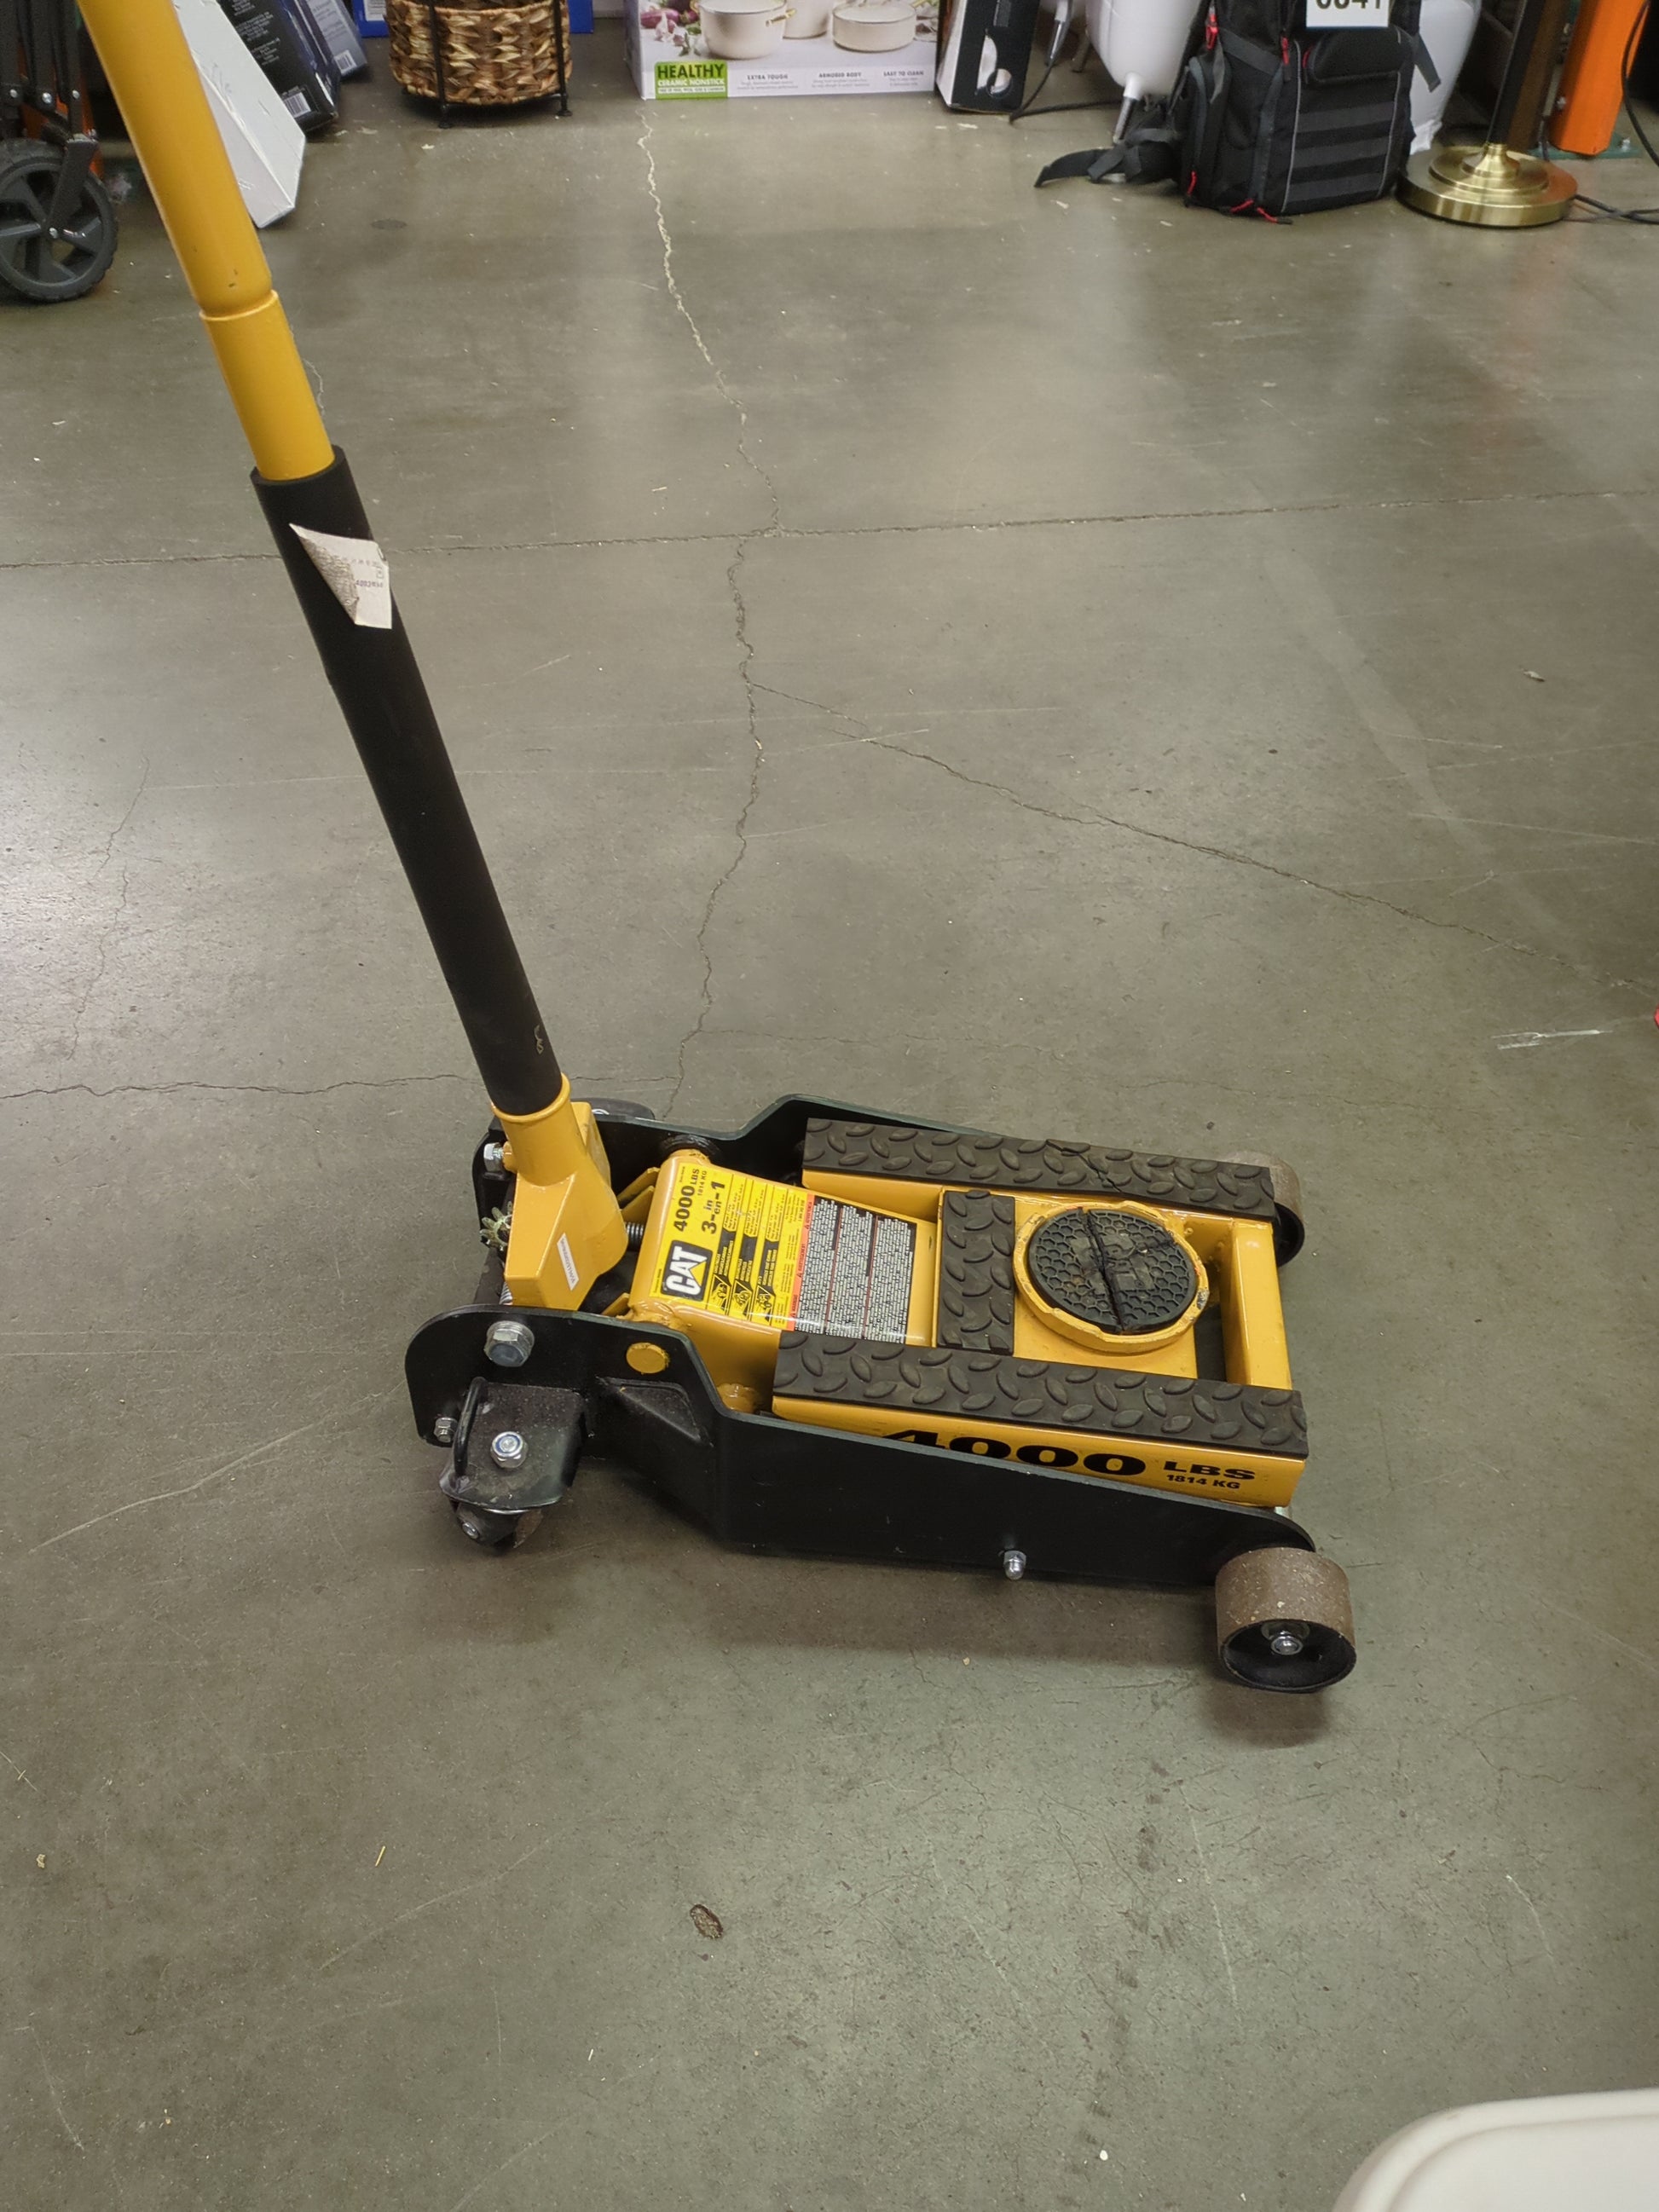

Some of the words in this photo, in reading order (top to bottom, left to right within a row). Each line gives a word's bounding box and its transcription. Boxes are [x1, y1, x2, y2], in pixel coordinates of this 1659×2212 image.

[657, 64, 725, 78] HEALTHY
[701, 1170, 708, 1181] KG
[673, 1186, 695, 1232] 4000
[690, 1169, 699, 1185] LBS
[666, 1245, 707, 1295] CAT
[882, 1429, 1146, 1476] 4000
[1164, 1461, 1255, 1480] LBS
[1167, 1475, 1207, 1485] 1814
[1212, 1480, 1240, 1489] KG
